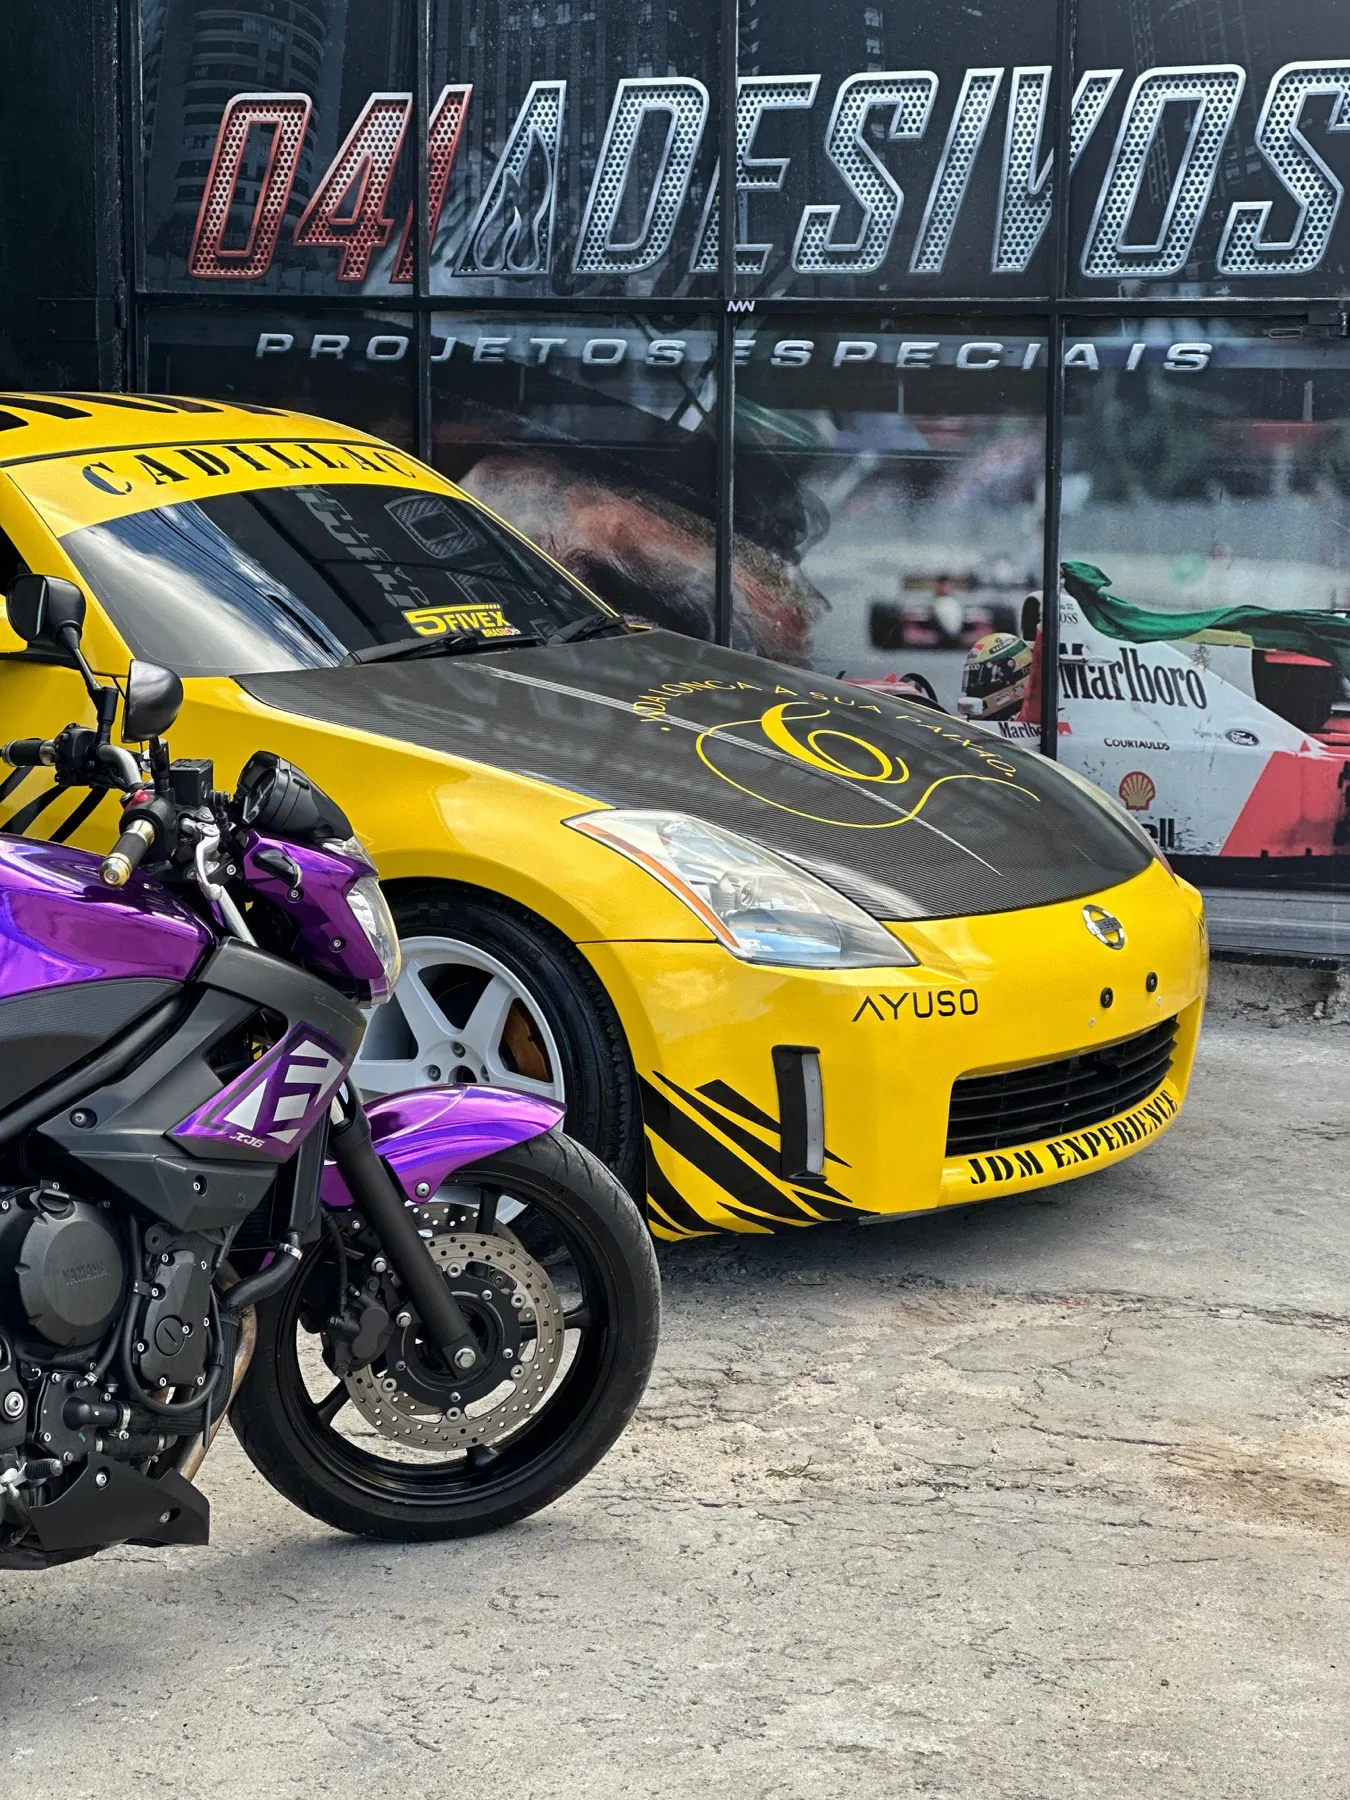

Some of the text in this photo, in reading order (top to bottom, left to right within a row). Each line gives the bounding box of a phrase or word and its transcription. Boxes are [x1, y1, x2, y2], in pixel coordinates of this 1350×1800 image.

[255, 332, 1214, 371] PROJETOS ESPECIAIS
[81, 443, 417, 496] CADILLAC
[1060, 612, 1079, 625] OSS
[1059, 643, 1208, 710] Marlboro
[809, 691, 882, 714] SUA
[1104, 737, 1170, 751] COURTAULDS
[1141, 817, 1175, 848] ell
[852, 988, 979, 1022] AYUSO
[968, 1089, 1179, 1185] JDM EXPERIENCE
[62, 1262, 107, 1285] YAMAHA
